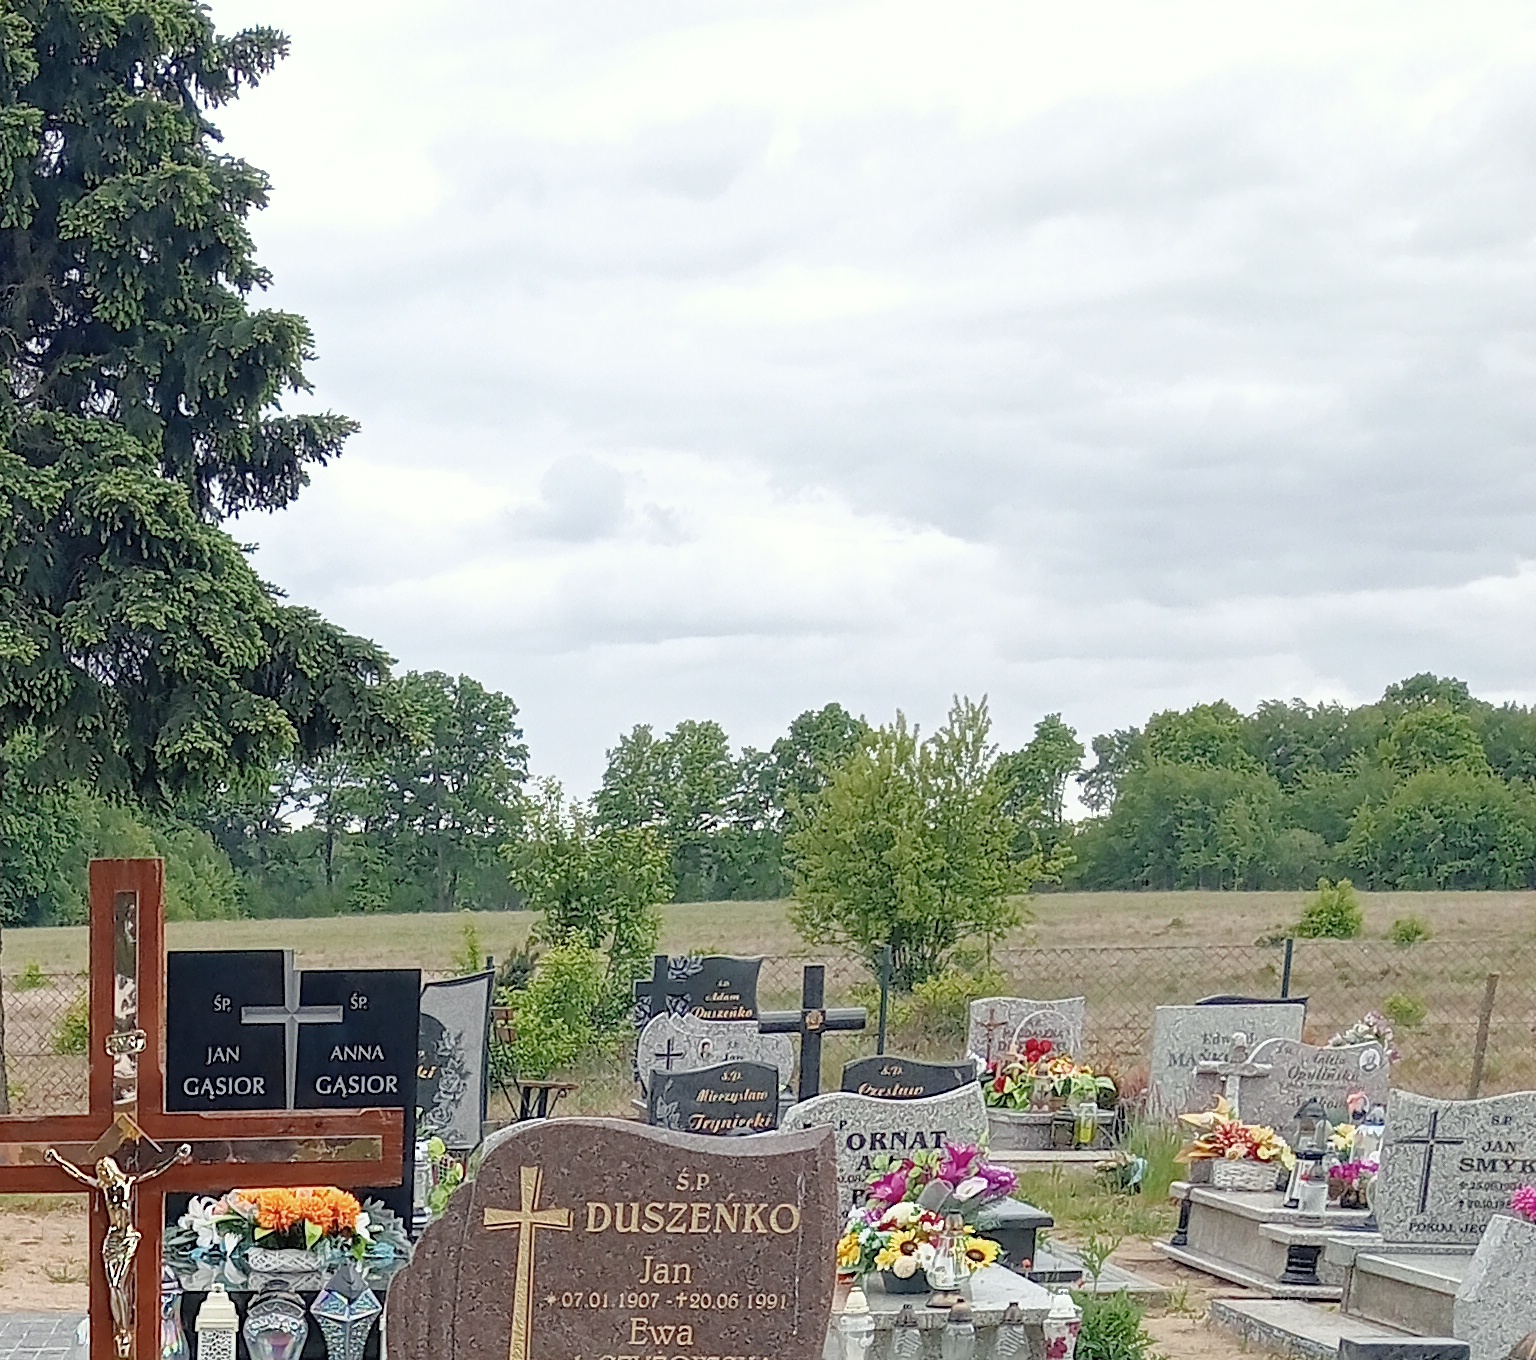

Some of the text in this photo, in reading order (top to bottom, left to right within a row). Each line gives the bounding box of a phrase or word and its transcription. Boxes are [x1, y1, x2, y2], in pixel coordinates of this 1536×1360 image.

[204, 1045, 241, 1066] JAN
[329, 1044, 385, 1062] ANNA
[182, 1076, 266, 1100] GĄSIOR
[315, 1075, 398, 1098] GĄSIOR
[846, 1131, 947, 1151] ORNAT
[1481, 1140, 1516, 1153] JAN
[585, 1193, 802, 1235] DUSZEŃKO
[639, 1255, 692, 1285] Jan
[628, 1317, 694, 1347] Ewa
